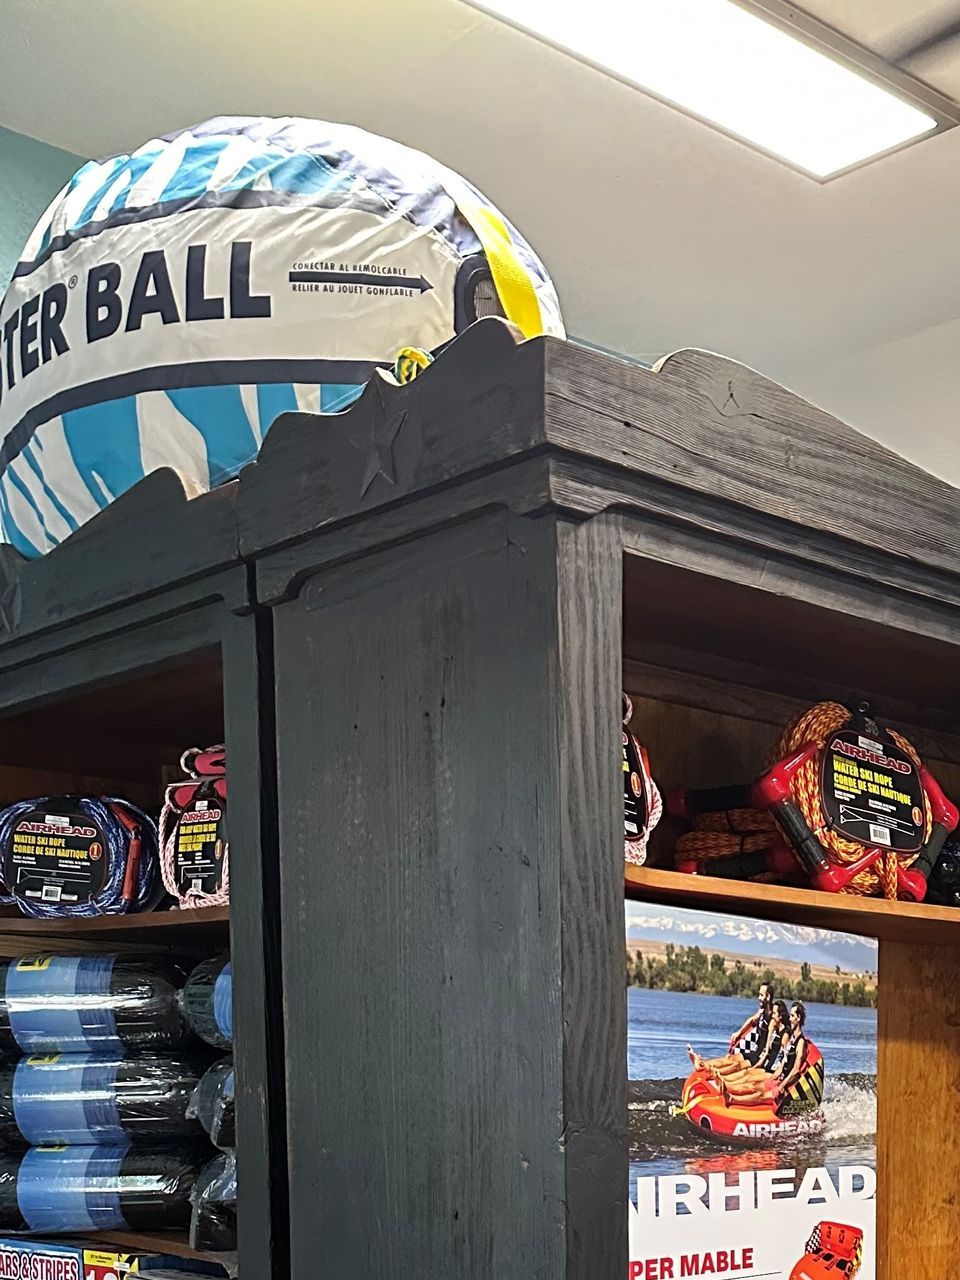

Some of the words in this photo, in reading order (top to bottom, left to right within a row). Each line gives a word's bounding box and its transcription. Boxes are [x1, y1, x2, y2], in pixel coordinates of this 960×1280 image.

[293, 262, 335, 270] CONECTAR
[353, 264, 407, 276] REMOLCABLE
[86, 241, 271, 344] BALL
[292, 284, 319, 292] RELIER
[323, 285, 334, 293] AU
[338, 285, 363, 294] JOUET
[366, 287, 413, 297] GONFLABLE
[831, 738, 912, 775] AIRHEAD
[833, 759, 859, 778] WATER
[860, 768, 874, 782] SKI
[874, 771, 893, 789] ROPE
[833, 772, 858, 789] CORDE
[858, 779, 868, 792] DE
[868, 782, 880, 796] SKI
[880, 787, 912, 806] NAUTIQUE
[180, 808, 221, 824] AIRHEAD
[16, 821, 97, 838] AIRHEAD
[13, 834, 36, 844] WATER
[37, 836, 48, 846] SKI
[49, 838, 65, 847] ROPE
[13, 844, 35, 854] CORDE
[35, 846, 44, 856] DE
[45, 847, 56, 857] SKI
[57, 848, 88, 859] NAUTIQUE
[732, 1120, 822, 1138] AIRHEAD
[629, 1165, 877, 1217] IRHEAD
[680, 1247, 753, 1277] MABLE
